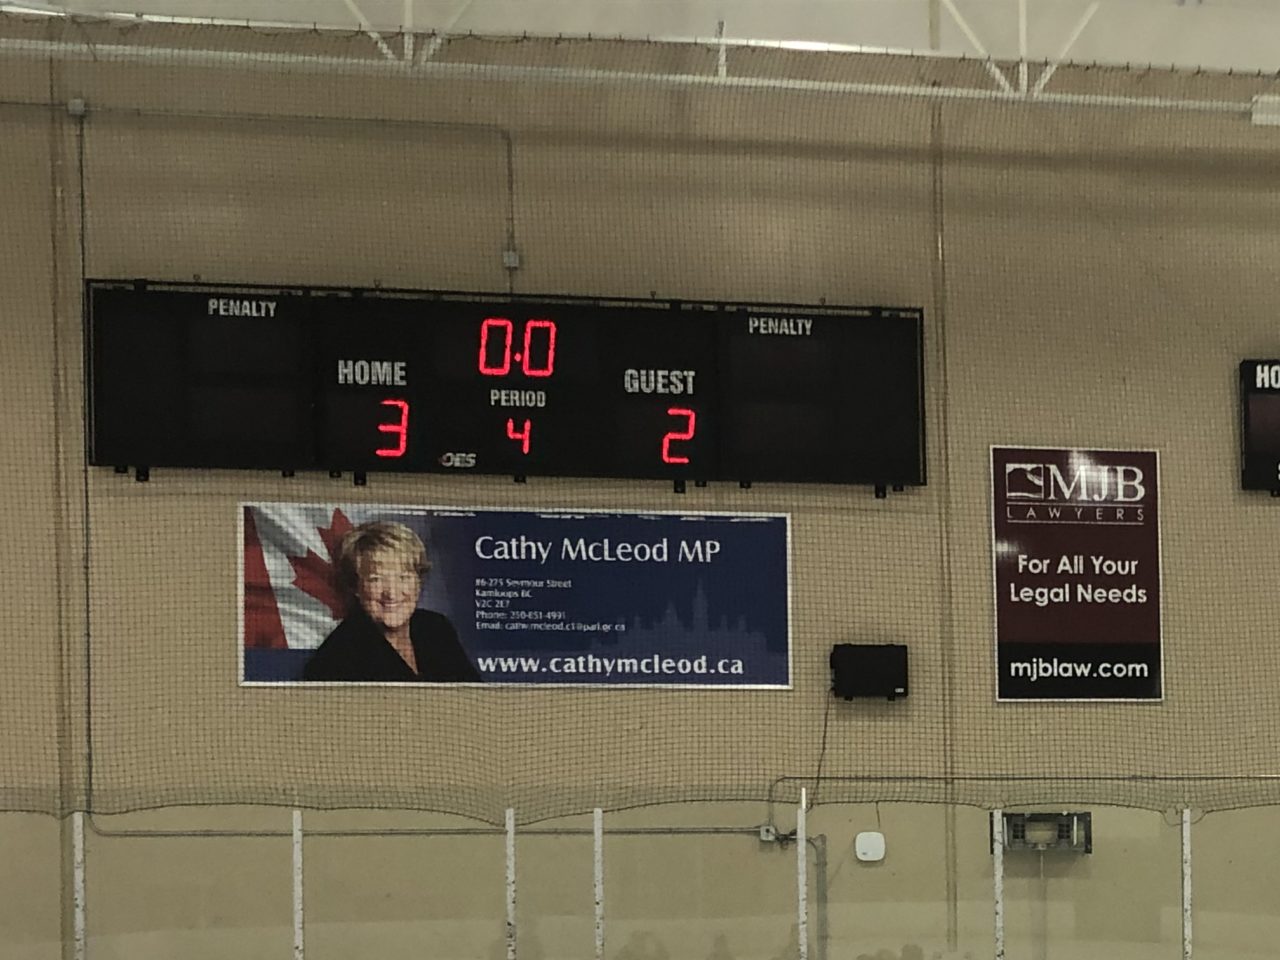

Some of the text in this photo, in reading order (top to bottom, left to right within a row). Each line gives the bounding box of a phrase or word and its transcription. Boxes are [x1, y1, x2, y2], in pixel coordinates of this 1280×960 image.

[207, 299, 277, 317] PENALTY
[748, 317, 813, 336] PENALTY
[337, 360, 407, 386] HOME
[624, 369, 696, 395] GUEST
[490, 389, 546, 407] PERIOD
[375, 400, 409, 457] 3
[506, 418, 531, 454] 4
[662, 408, 695, 463] 2
[1045, 464, 1146, 502] MJB
[1006, 507, 1144, 521] LAWYERS
[475, 536, 720, 564] Cathy McLeod MP
[1018, 555, 1138, 576] For All Your
[1010, 583, 1147, 606] Legal Needs
[477, 654, 744, 677] www.cathymcleod.ca
[1010, 658, 1148, 681] mjblaw.com
